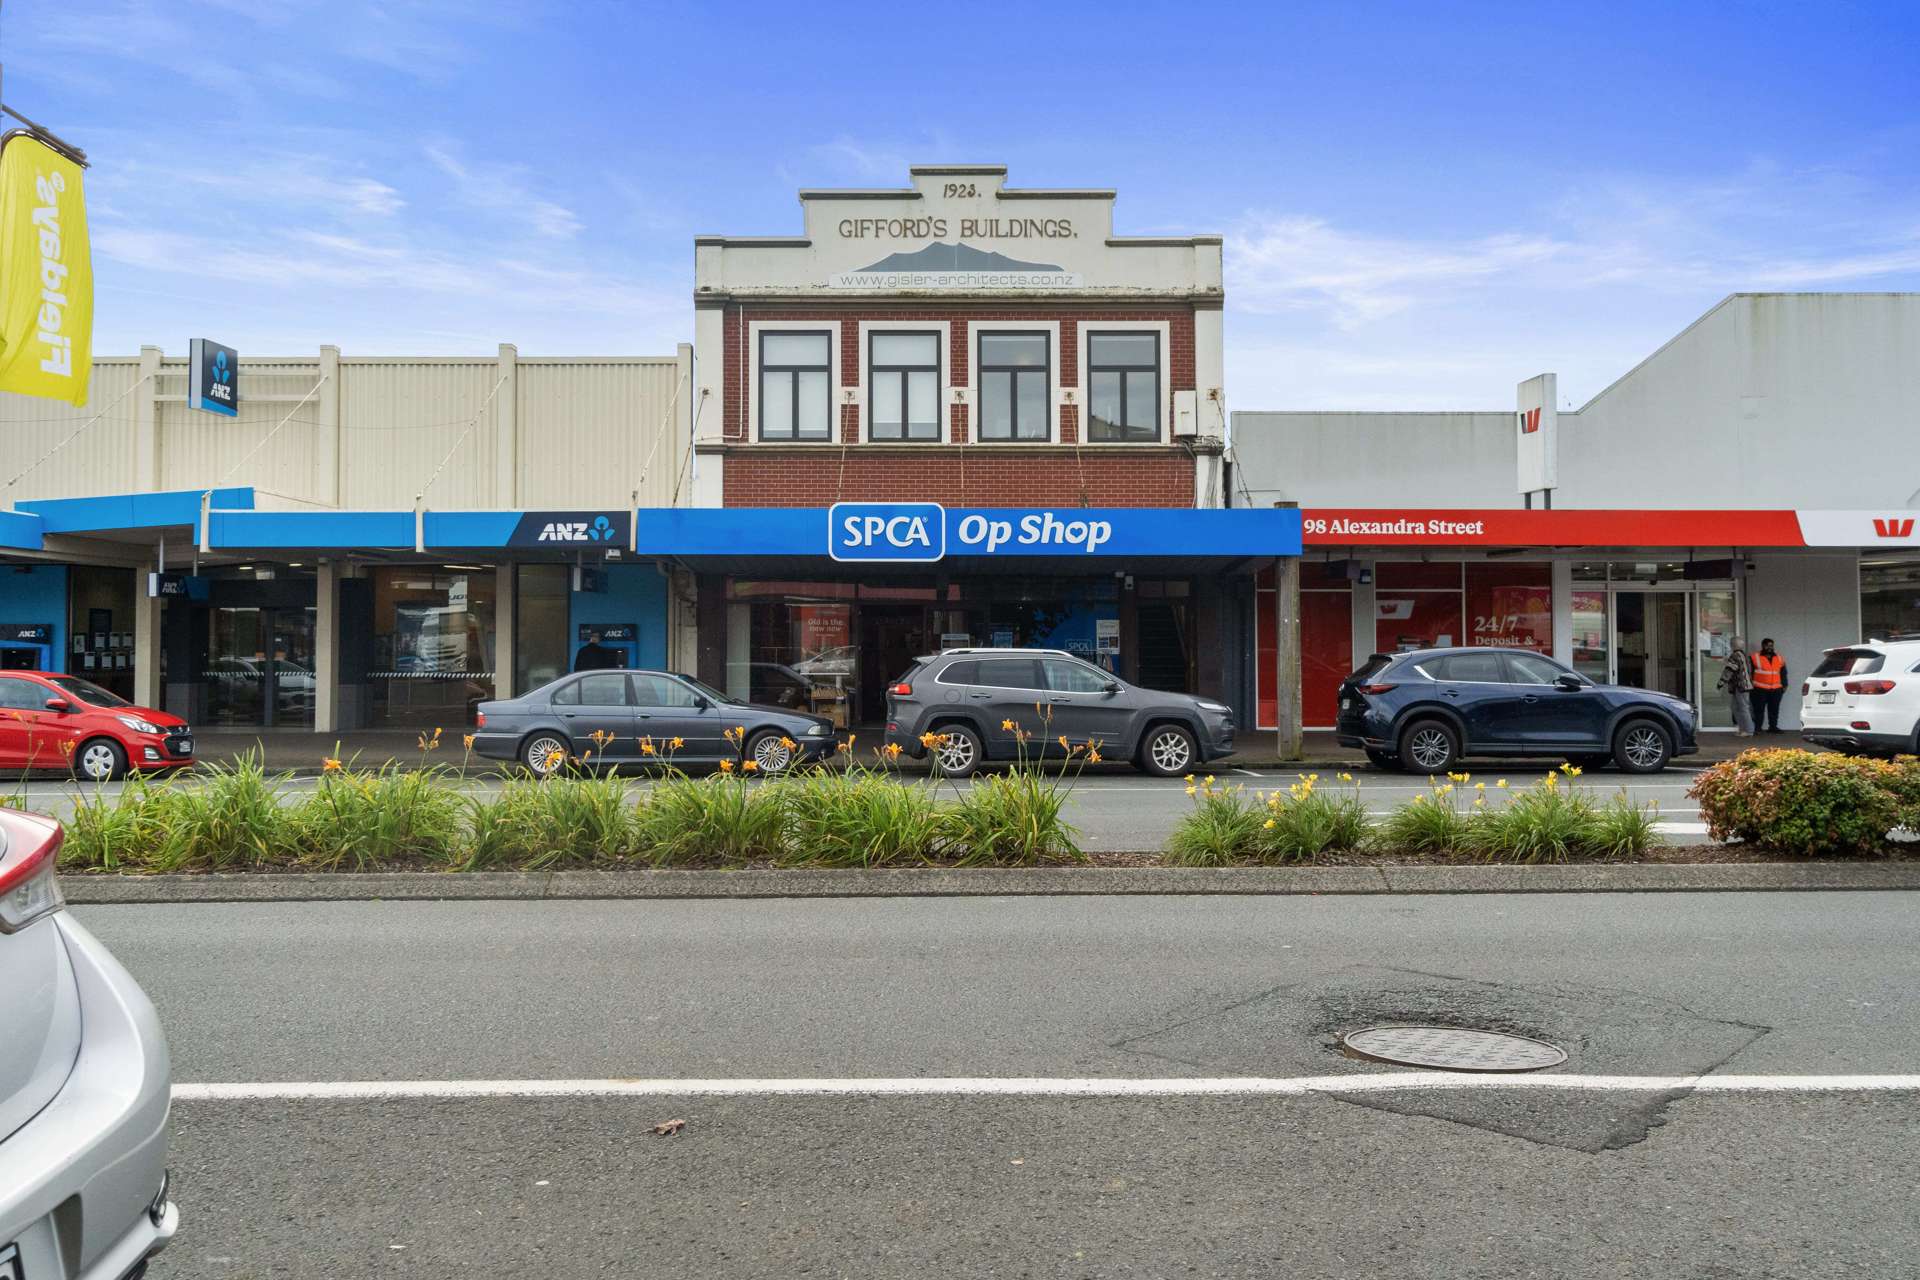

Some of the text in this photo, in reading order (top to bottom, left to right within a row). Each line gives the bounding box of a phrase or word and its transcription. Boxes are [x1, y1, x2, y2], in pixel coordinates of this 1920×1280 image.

[838, 215, 1078, 238] GIFFORD'S BUILDINGS.
[840, 273, 1074, 288] www.gisler-architects.co.nz
[210, 382, 231, 402] ANZ
[538, 522, 589, 541] ANZ
[958, 512, 1112, 553] Op Shop
[1303, 518, 1484, 535] 98 Alexandra Street
[162, 582, 178, 593] ANZ
[1474, 615, 1518, 634] 24/7
[17, 630, 36, 638] ANZ
[605, 630, 623, 638] ANZ
[1475, 635, 1520, 648] Deposit
